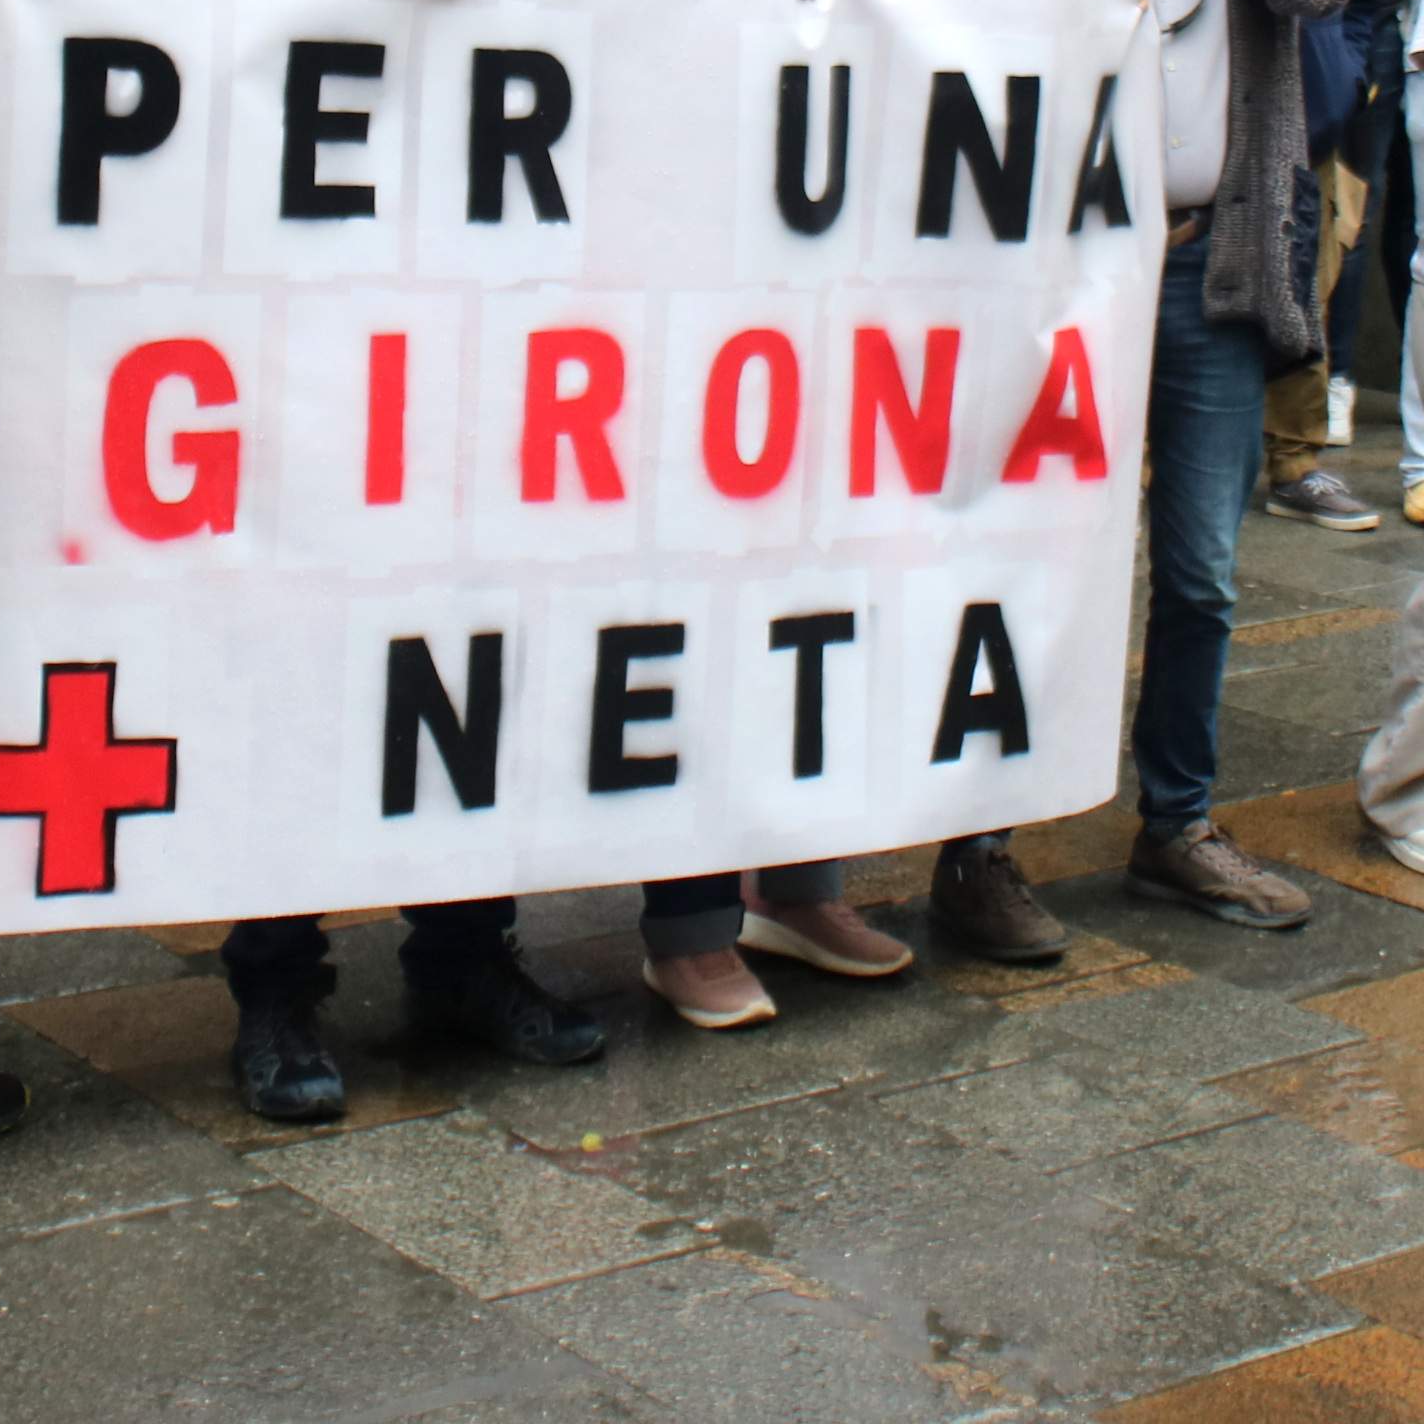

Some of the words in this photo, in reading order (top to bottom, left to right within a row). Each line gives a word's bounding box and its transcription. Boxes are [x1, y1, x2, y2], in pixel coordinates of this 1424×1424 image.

[57, 36, 573, 226] PER
[776, 65, 1132, 242] UNA
[101, 326, 1108, 542] GIRONA
[380, 601, 1031, 817] NETA
